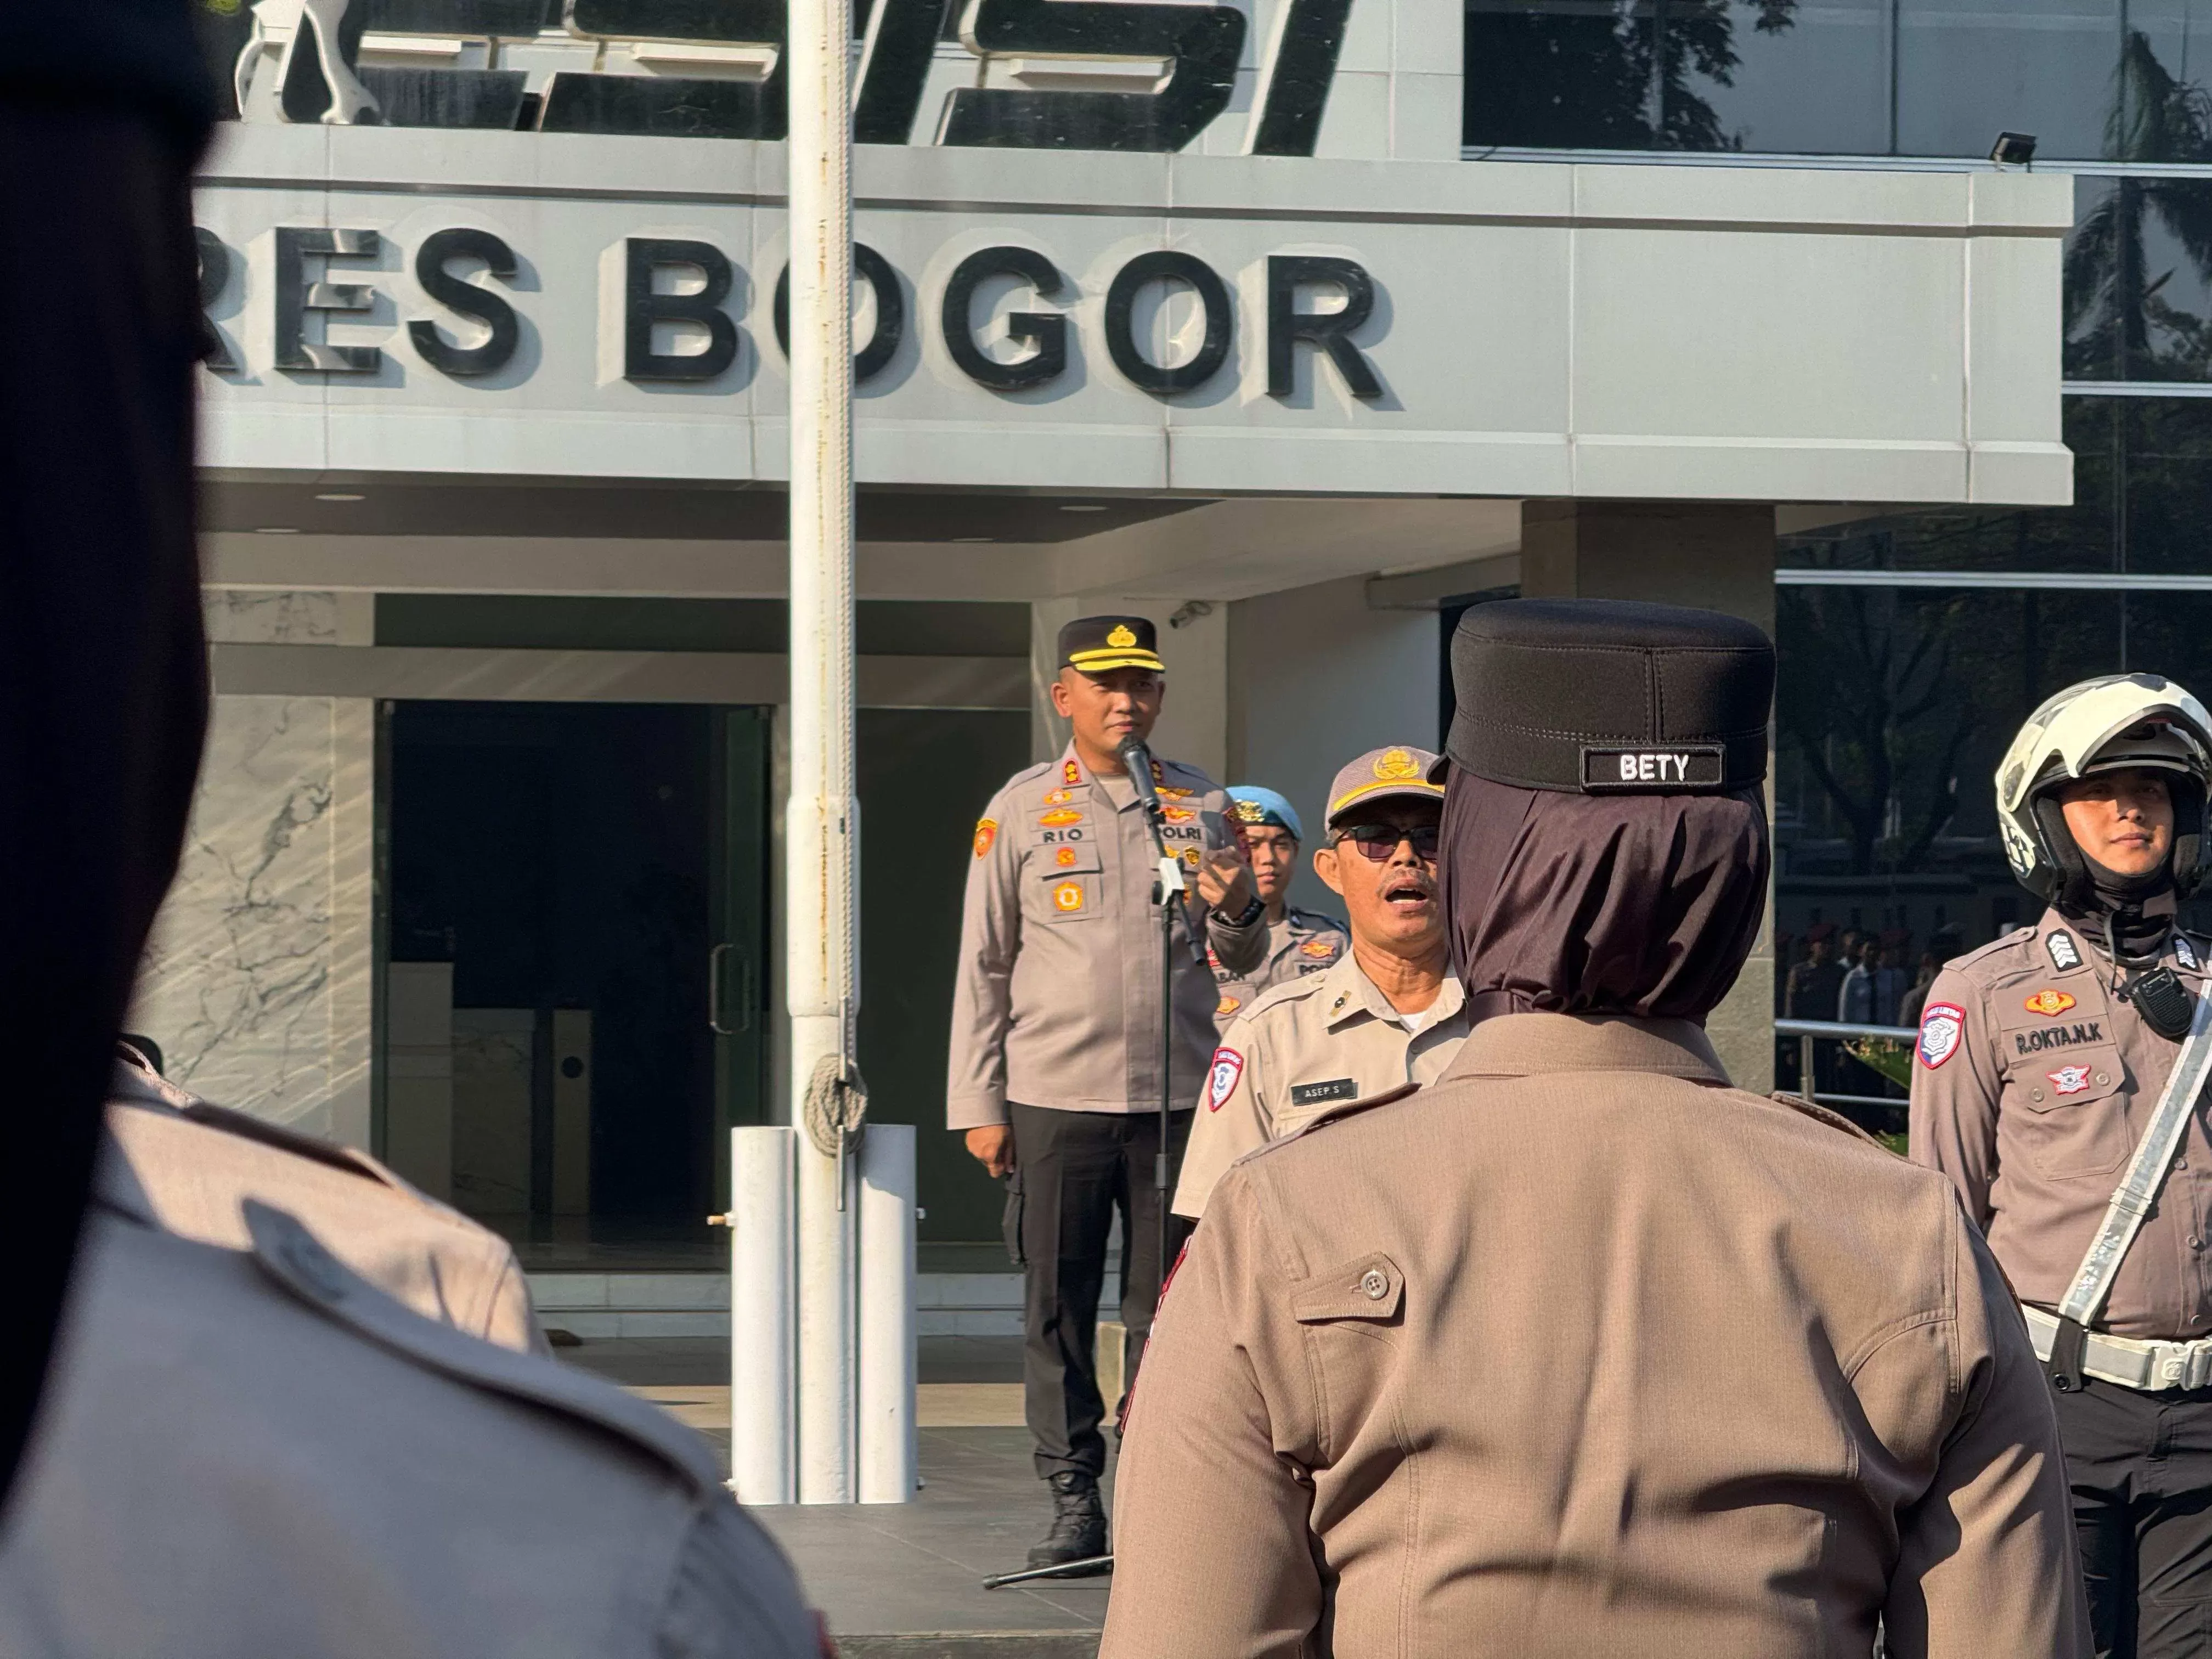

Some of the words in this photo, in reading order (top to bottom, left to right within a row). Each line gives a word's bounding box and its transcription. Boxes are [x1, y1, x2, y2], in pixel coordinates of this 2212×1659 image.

[623, 237, 1386, 400] BOGOR
[1620, 754, 1689, 781] BETY
[1043, 828, 1083, 843] RIO
[1158, 826, 1201, 839] OLRI
[2015, 1022, 2103, 1055] R.OKTA.N.K
[1305, 1087, 1330, 1098] ASEP
[1334, 1086, 1340, 1094] S
